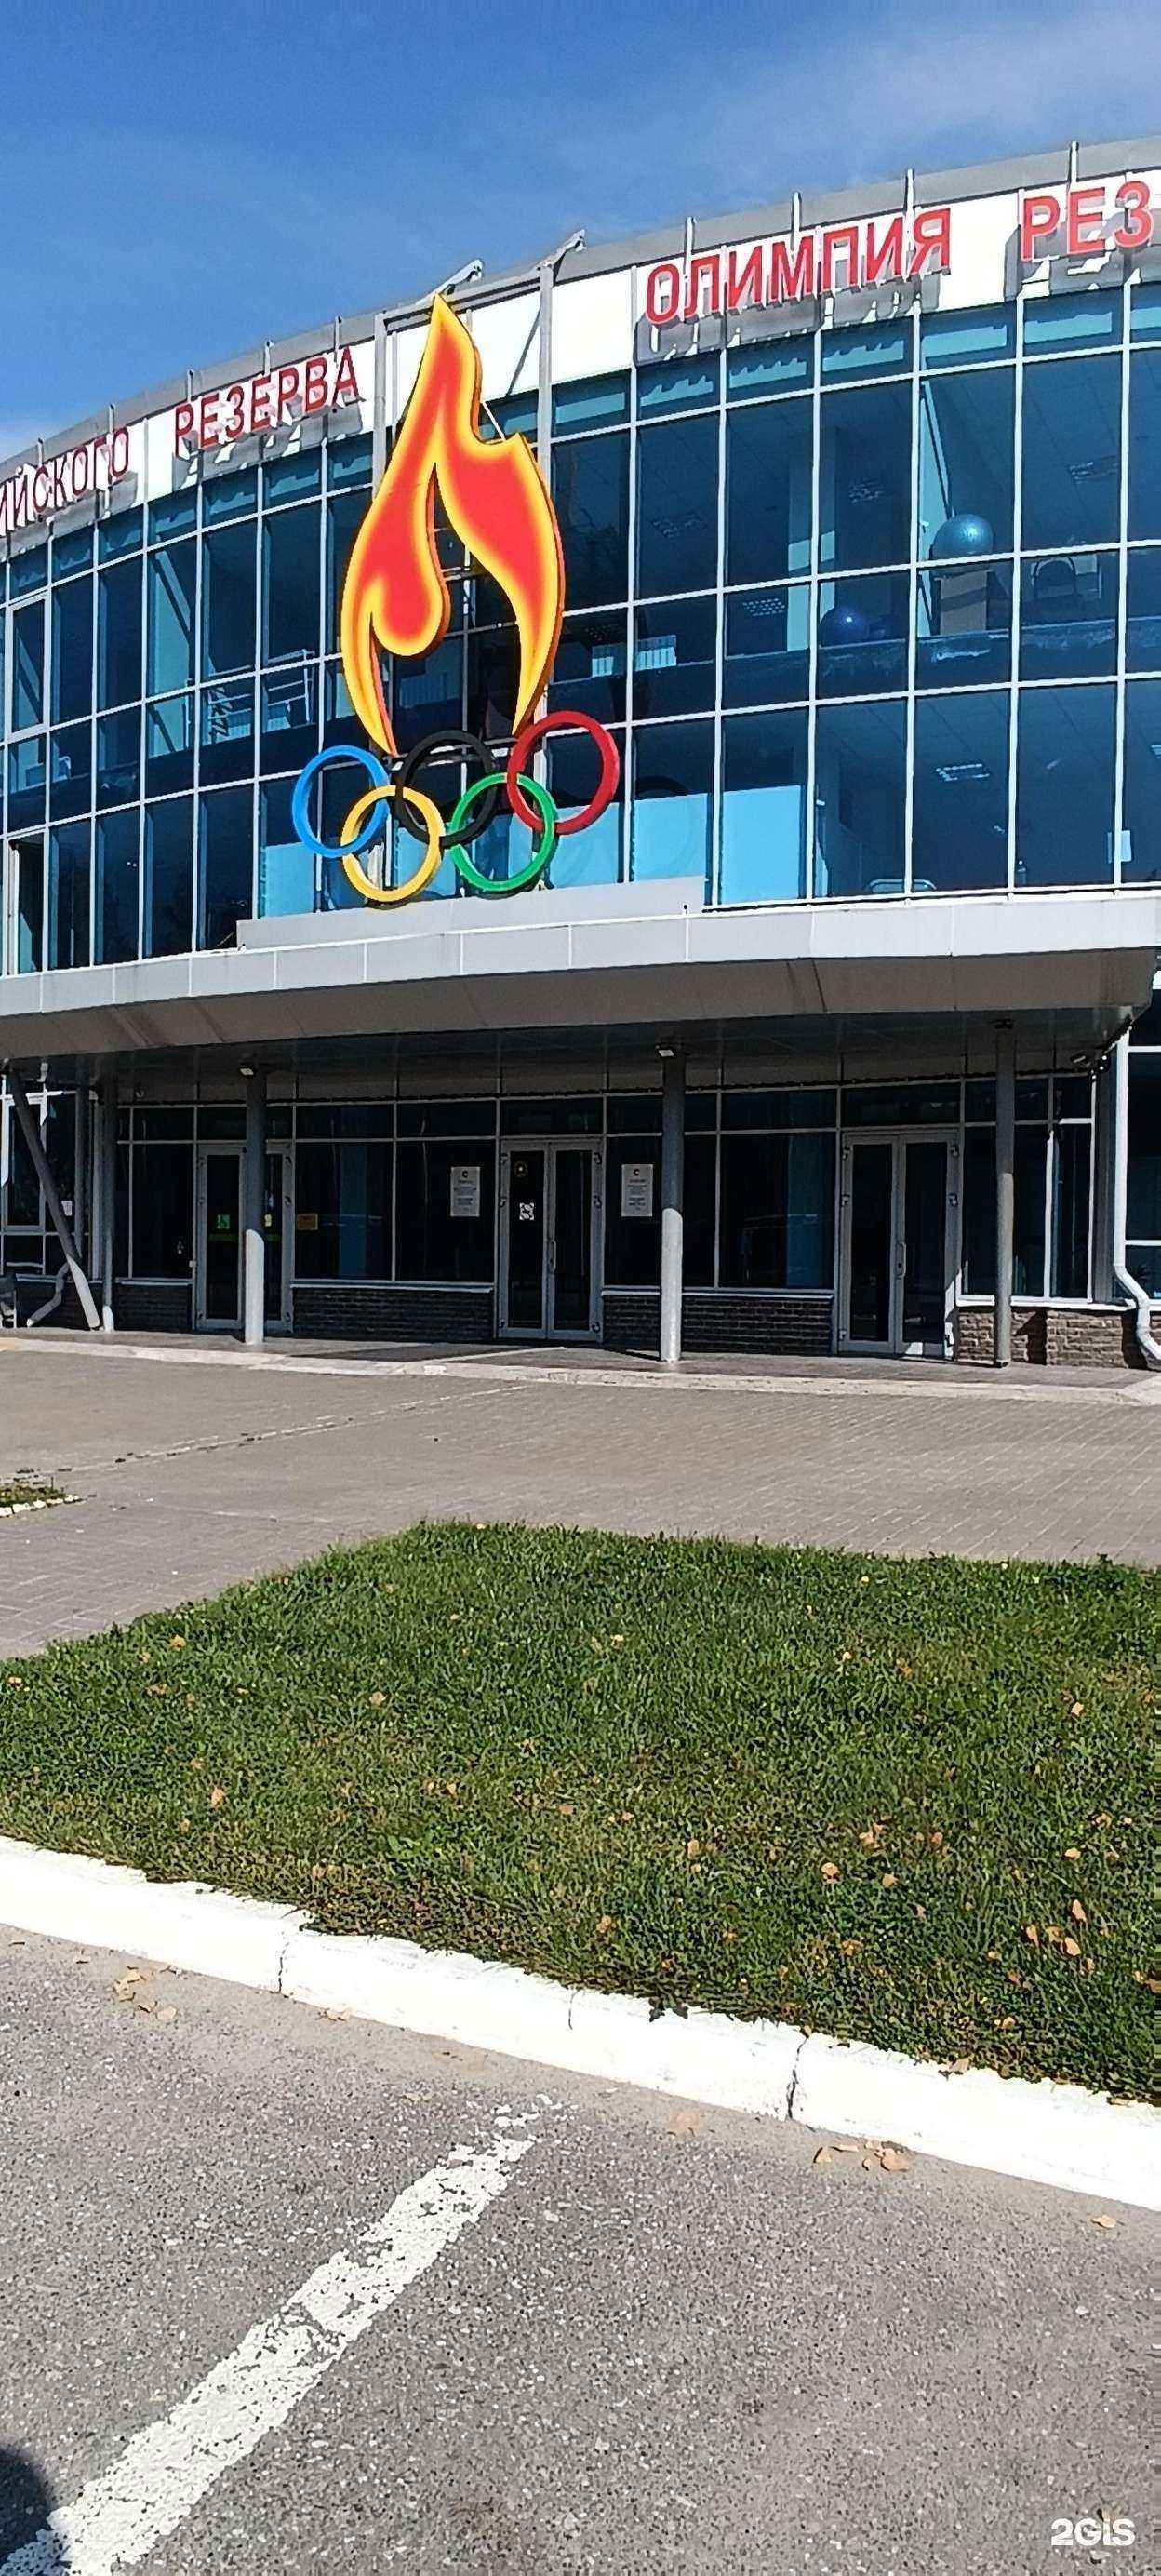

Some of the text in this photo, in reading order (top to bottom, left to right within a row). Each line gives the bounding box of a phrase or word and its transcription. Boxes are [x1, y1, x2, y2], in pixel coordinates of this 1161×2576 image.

[646, 181, 1154, 324] ОЛИМПИЯ РЕЗ
[175, 346, 361, 458] РЕЗЕРВА
